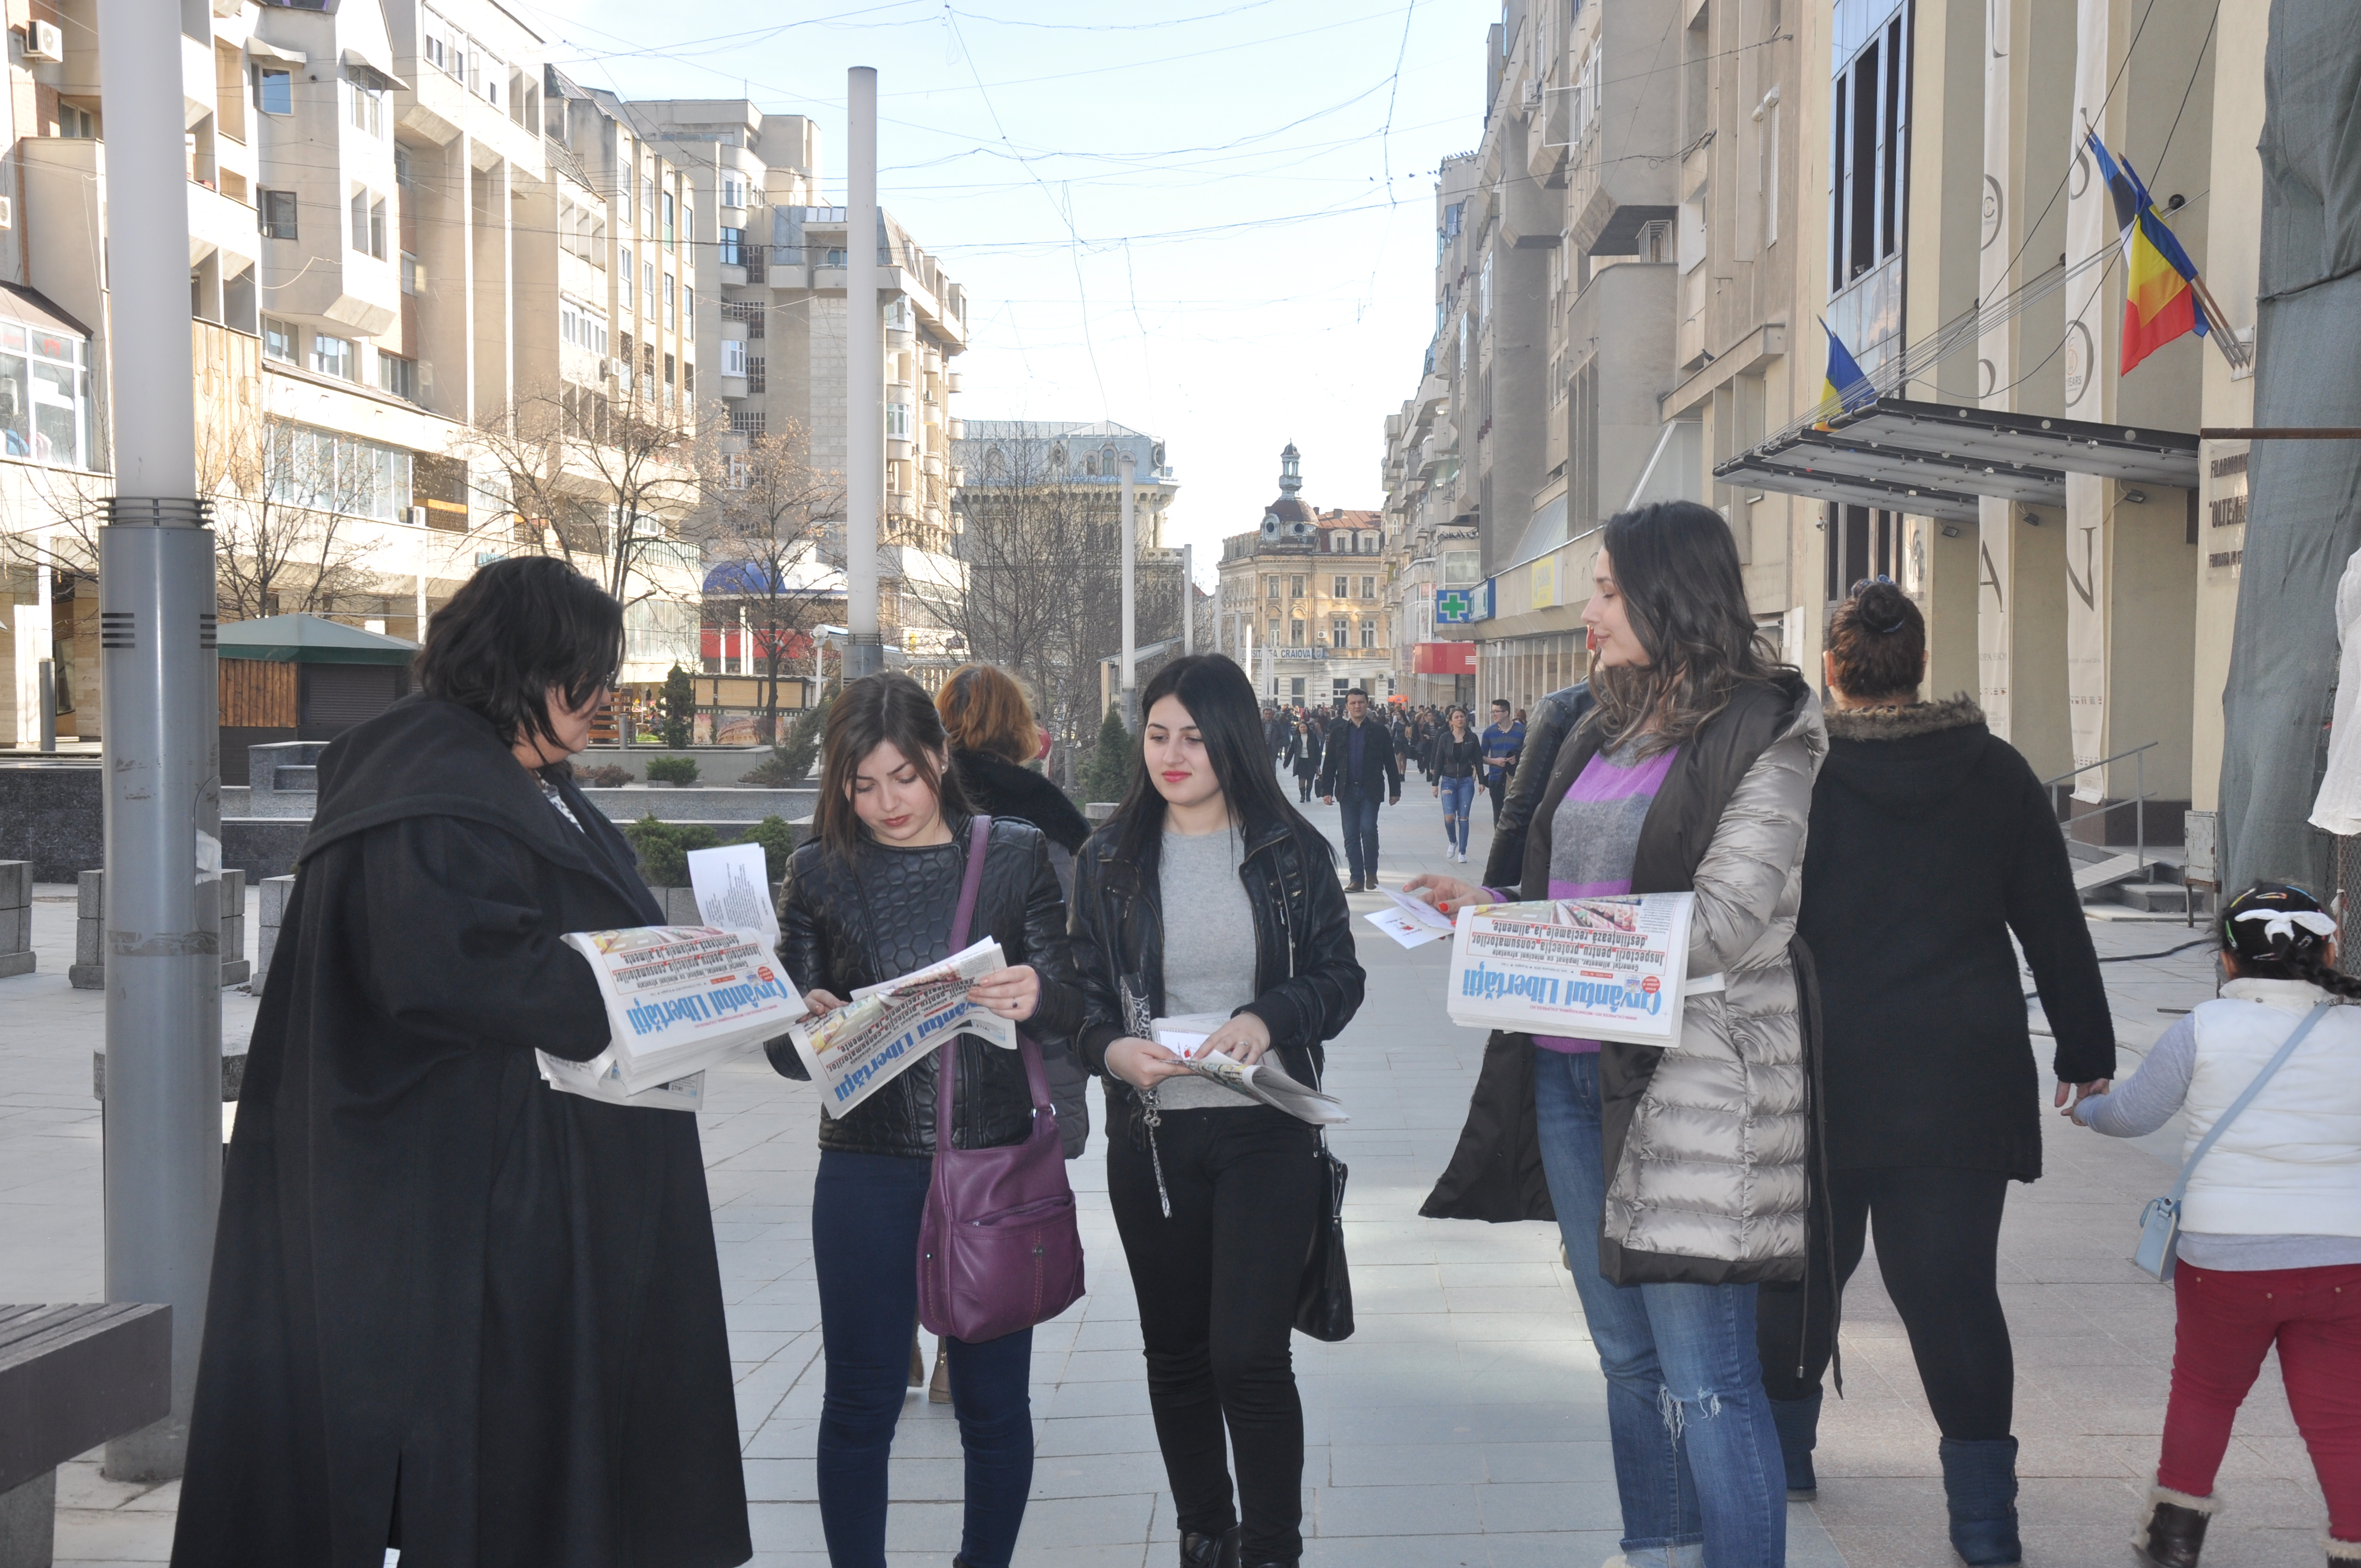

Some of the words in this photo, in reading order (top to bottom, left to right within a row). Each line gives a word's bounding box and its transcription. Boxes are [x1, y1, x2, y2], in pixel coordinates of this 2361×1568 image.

[2067, 376, 2082, 387] YEARS
[2210, 453, 2249, 478] FILARMONIC
[1281, 649, 1311, 658] CRAIOVA
[1493, 922, 1530, 936] alimente
[1534, 926, 1542, 938] la
[1546, 927, 1588, 941] reclamele
[655, 949, 664, 960] la
[665, 941, 698, 960] reclamele
[701, 950, 723, 966] pentru
[725, 945, 761, 962] Inspectorii
[1492, 949, 1517, 958] sfruntate
[1584, 946, 1612, 959] pentru
[1615, 950, 1663, 966] Inspectorii
[1581, 959, 1610, 968] alimentar,
[637, 980, 657, 989] sfruntate
[659, 976, 678, 984] minciuni
[1462, 961, 1559, 1004] Libertății
[707, 977, 787, 1016] Cuvântul
[920, 990, 946, 1008] pentru
[1565, 981, 1662, 1016] Cuvântul
[885, 995, 920, 1021] reclamele
[875, 1021, 882, 1030] la
[917, 1002, 978, 1039] vântul
[840, 1028, 872, 1053] alimente
